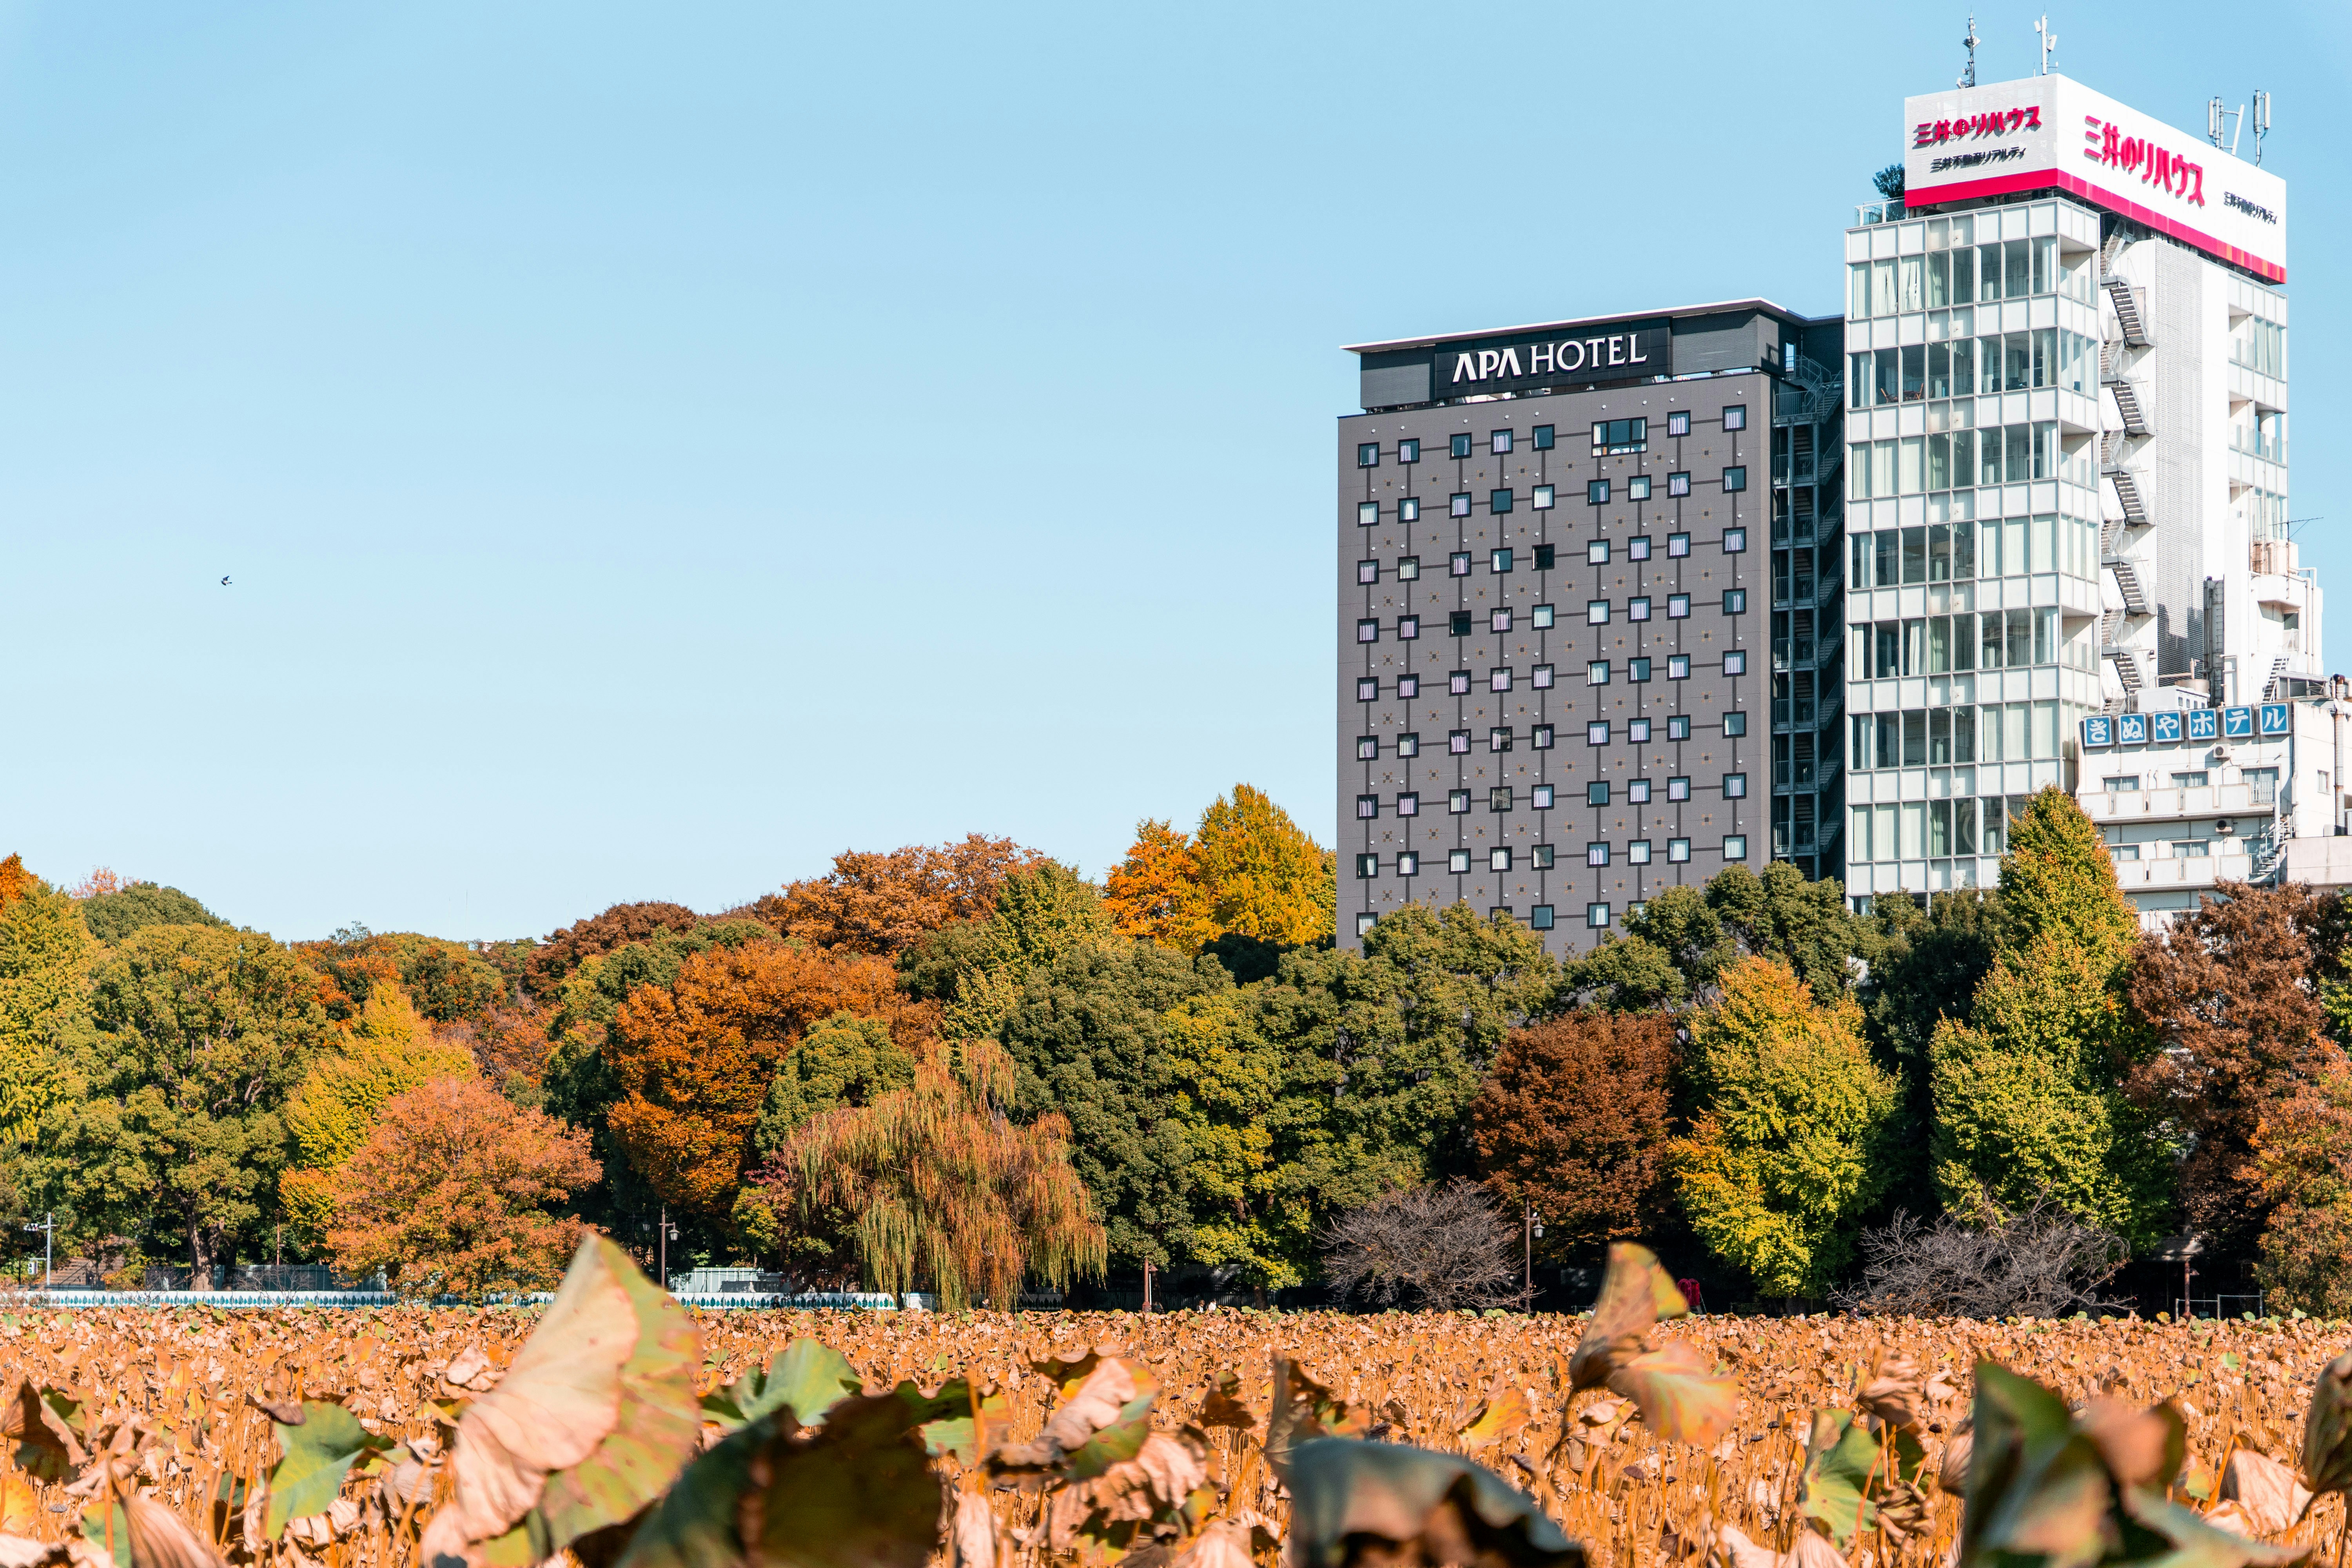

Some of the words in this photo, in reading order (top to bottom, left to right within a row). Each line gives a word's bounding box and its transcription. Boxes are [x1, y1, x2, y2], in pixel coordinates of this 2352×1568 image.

[1917, 106, 2042, 143] 三井のリハウス
[2084, 115, 2205, 206] 三井のリハウス
[1453, 348, 1522, 382] APA
[1530, 334, 1647, 374] HOTEL
[2089, 708, 2286, 742] きぬやホテル
